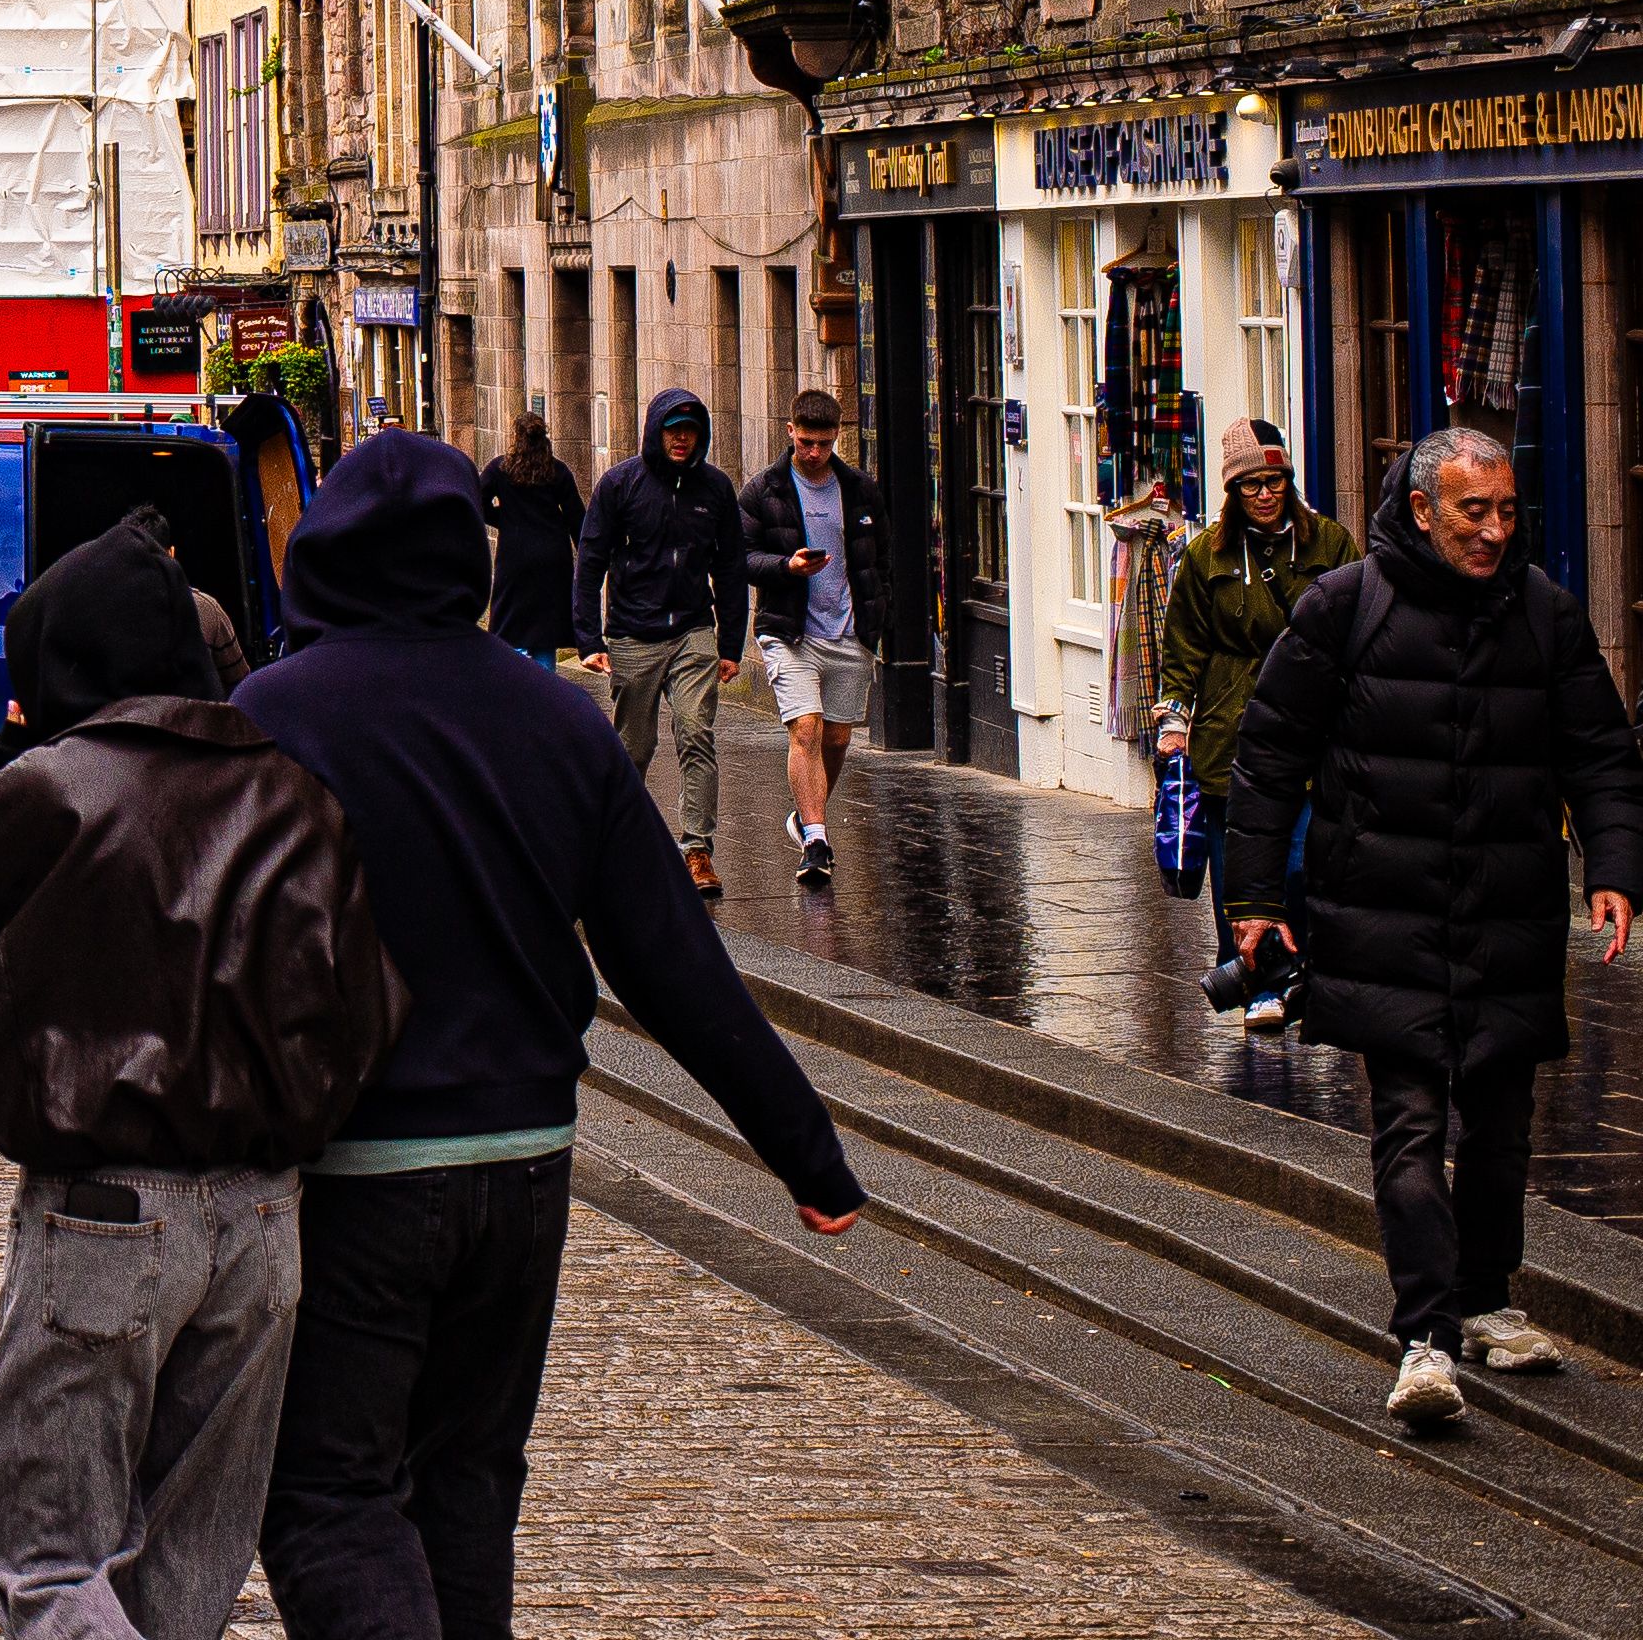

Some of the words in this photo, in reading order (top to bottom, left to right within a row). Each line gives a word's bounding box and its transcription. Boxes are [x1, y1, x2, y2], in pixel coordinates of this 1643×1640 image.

[1035, 124, 1092, 189] HOUSE
[1092, 123, 1117, 186] OF
[1118, 111, 1228, 184] CASHMERE
[1329, 104, 1421, 159] EDINBURGH
[1428, 95, 1527, 151] CASHMERE
[1536, 92, 1550, 144] &
[867, 149, 887, 190] The
[888, 144, 925, 198] Whisky
[926, 140, 949, 185] Trail
[141, 326, 190, 334] RESTAURANT
[241, 343, 260, 351] OPEN
